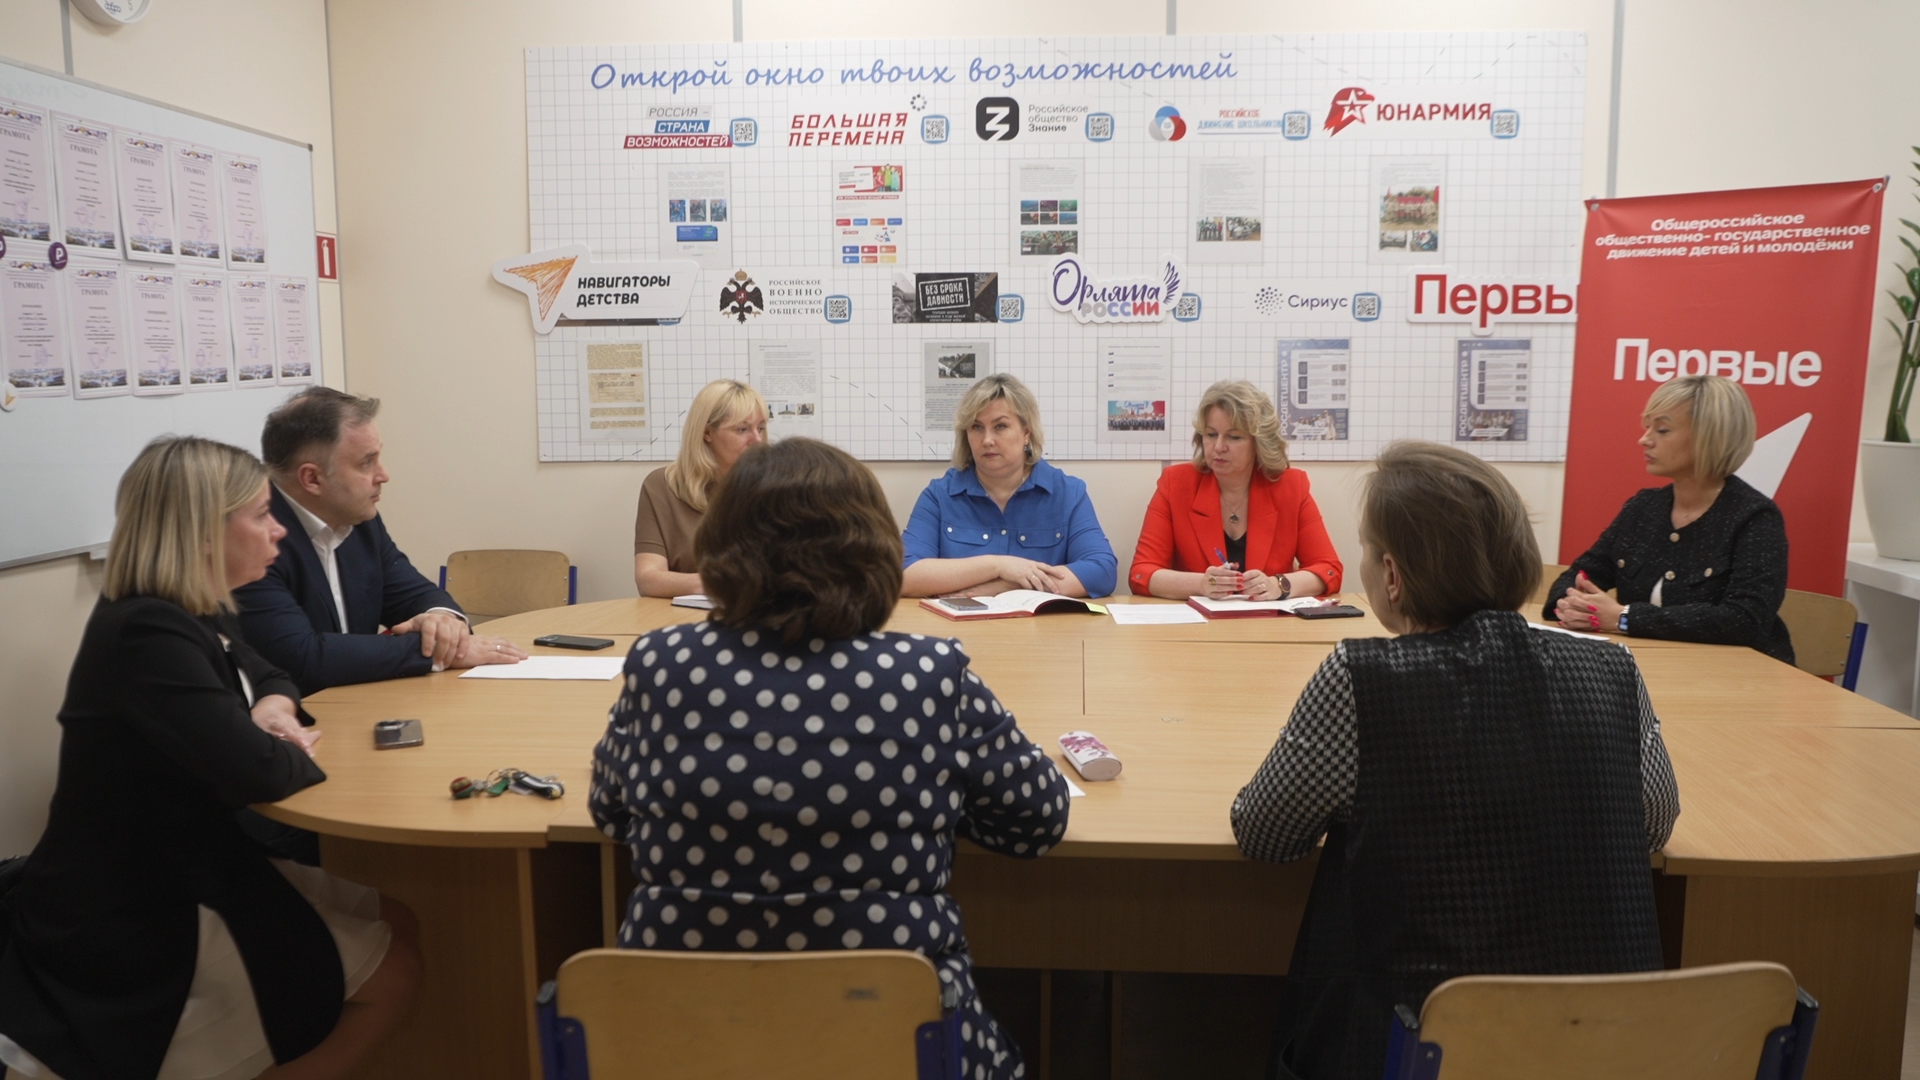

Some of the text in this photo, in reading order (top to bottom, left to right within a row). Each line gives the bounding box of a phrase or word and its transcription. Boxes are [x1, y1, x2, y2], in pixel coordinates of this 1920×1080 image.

[590, 52, 1238, 96] Открой окно твоих возможностей
[647, 107, 699, 119] РОССИЯ
[1028, 104, 1089, 113] Российское
[1376, 103, 1491, 121] ЮНАРМИЯ
[657, 120, 706, 133] СТРАНА
[791, 113, 908, 129] БОЛЬШАЯ
[1028, 114, 1078, 124] общество
[1028, 123, 1067, 132] Знание
[626, 134, 730, 148] ВОЗМОЖНОСТЕЙ
[789, 130, 905, 147] ПЕРЕМЕНА
[1651, 214, 1805, 232] Общероссийское
[1595, 223, 1871, 247] общественно- государственное
[1606, 244, 1688, 260] движение
[1689, 241, 1741, 258] детей
[1757, 238, 1854, 256] молодёжи
[577, 275, 671, 290] НАВИГАТОРЫ
[769, 278, 821, 286] РОССИЙСКОЕ
[925, 281, 964, 295] БЕЗ СРОКА
[1052, 259, 1160, 309] Орлята
[769, 288, 822, 296] ВОЕННО
[576, 293, 640, 308] ДЕТСТВА
[926, 293, 964, 307] ДАВНОСТИ
[1288, 294, 1348, 311] Сириус
[1414, 274, 1579, 328] Первы
[1081, 302, 1159, 317] РОССИИ
[1613, 338, 1822, 387] Первые
